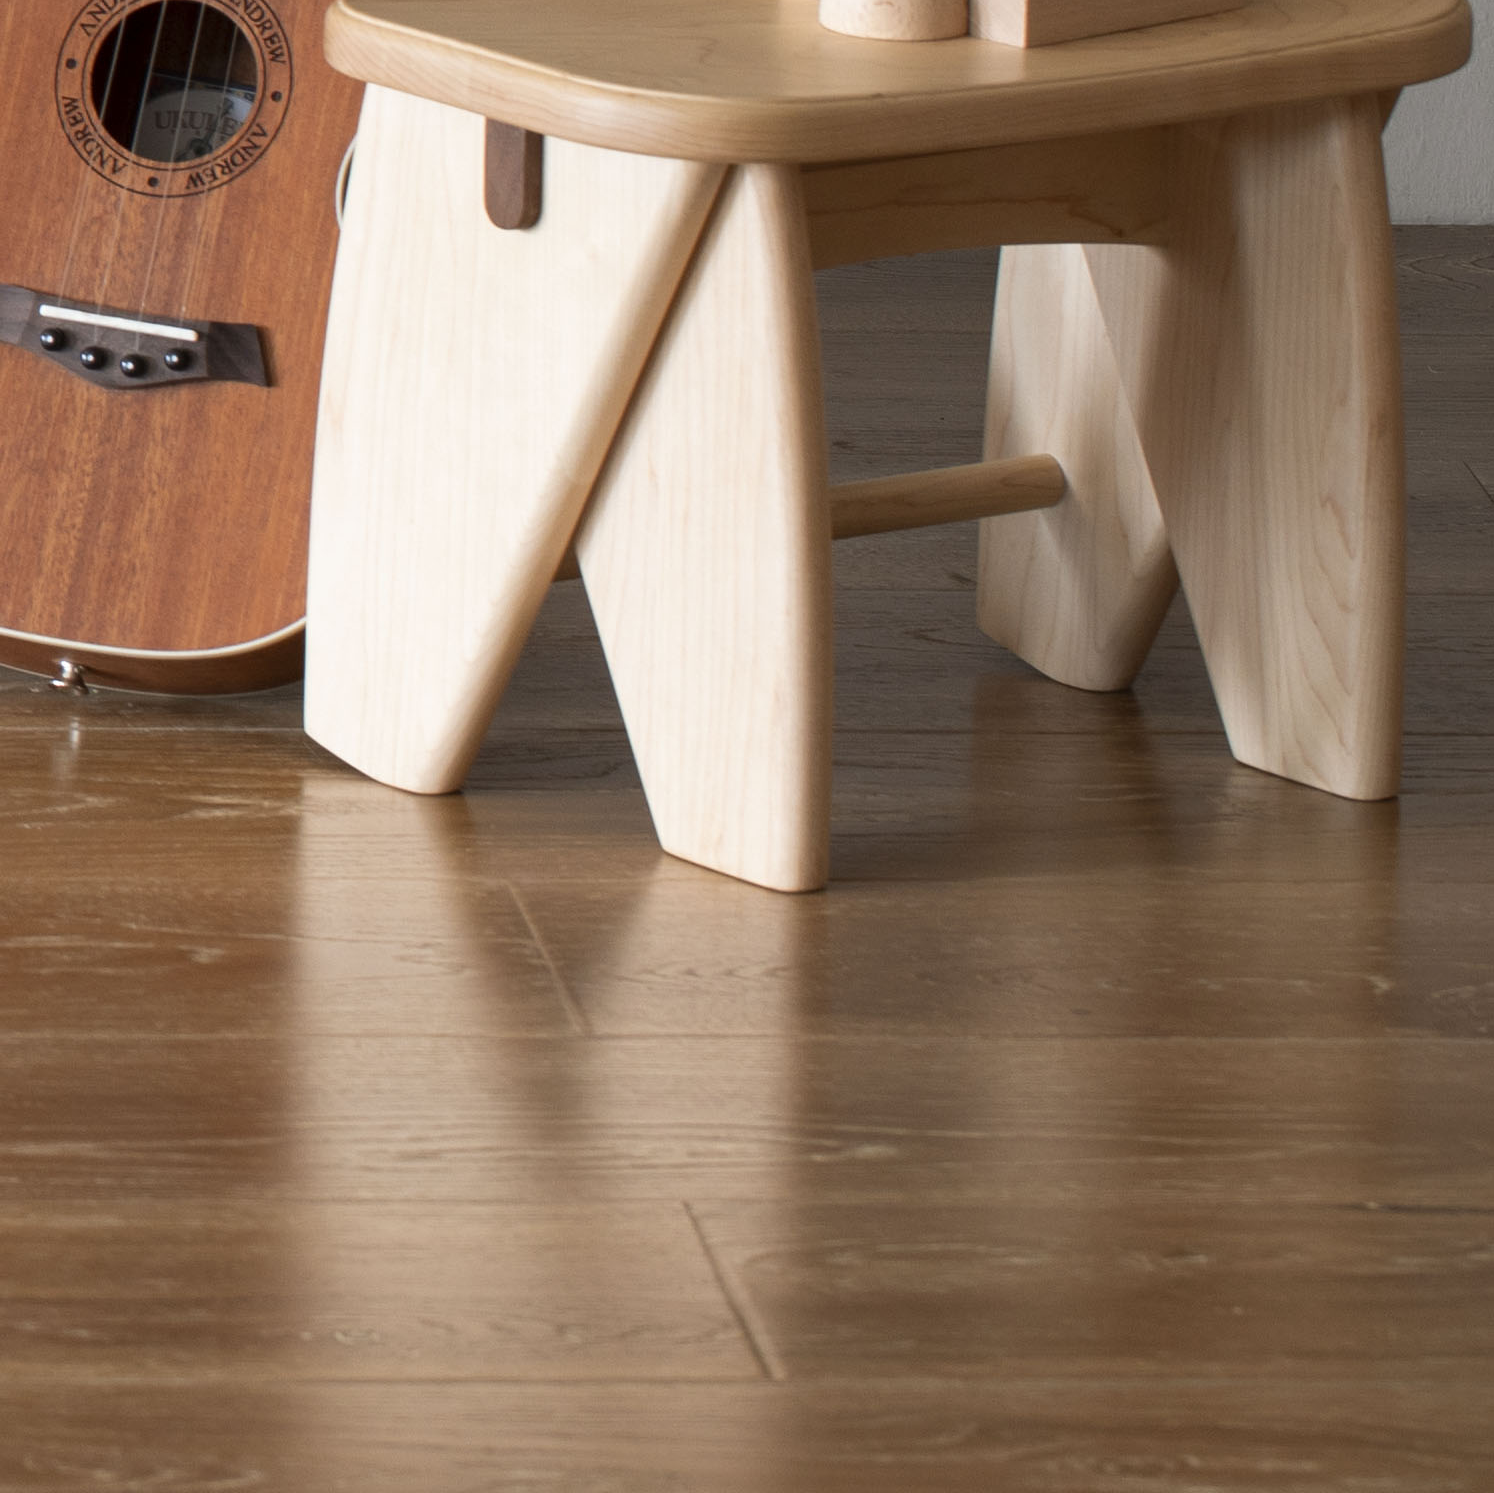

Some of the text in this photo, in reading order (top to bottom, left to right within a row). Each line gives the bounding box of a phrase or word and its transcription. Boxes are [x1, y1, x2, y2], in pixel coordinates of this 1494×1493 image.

[61, 95, 128, 176] ANDREW
[154, 110, 244, 134] UKULE
[185, 123, 269, 190] ANDREW
